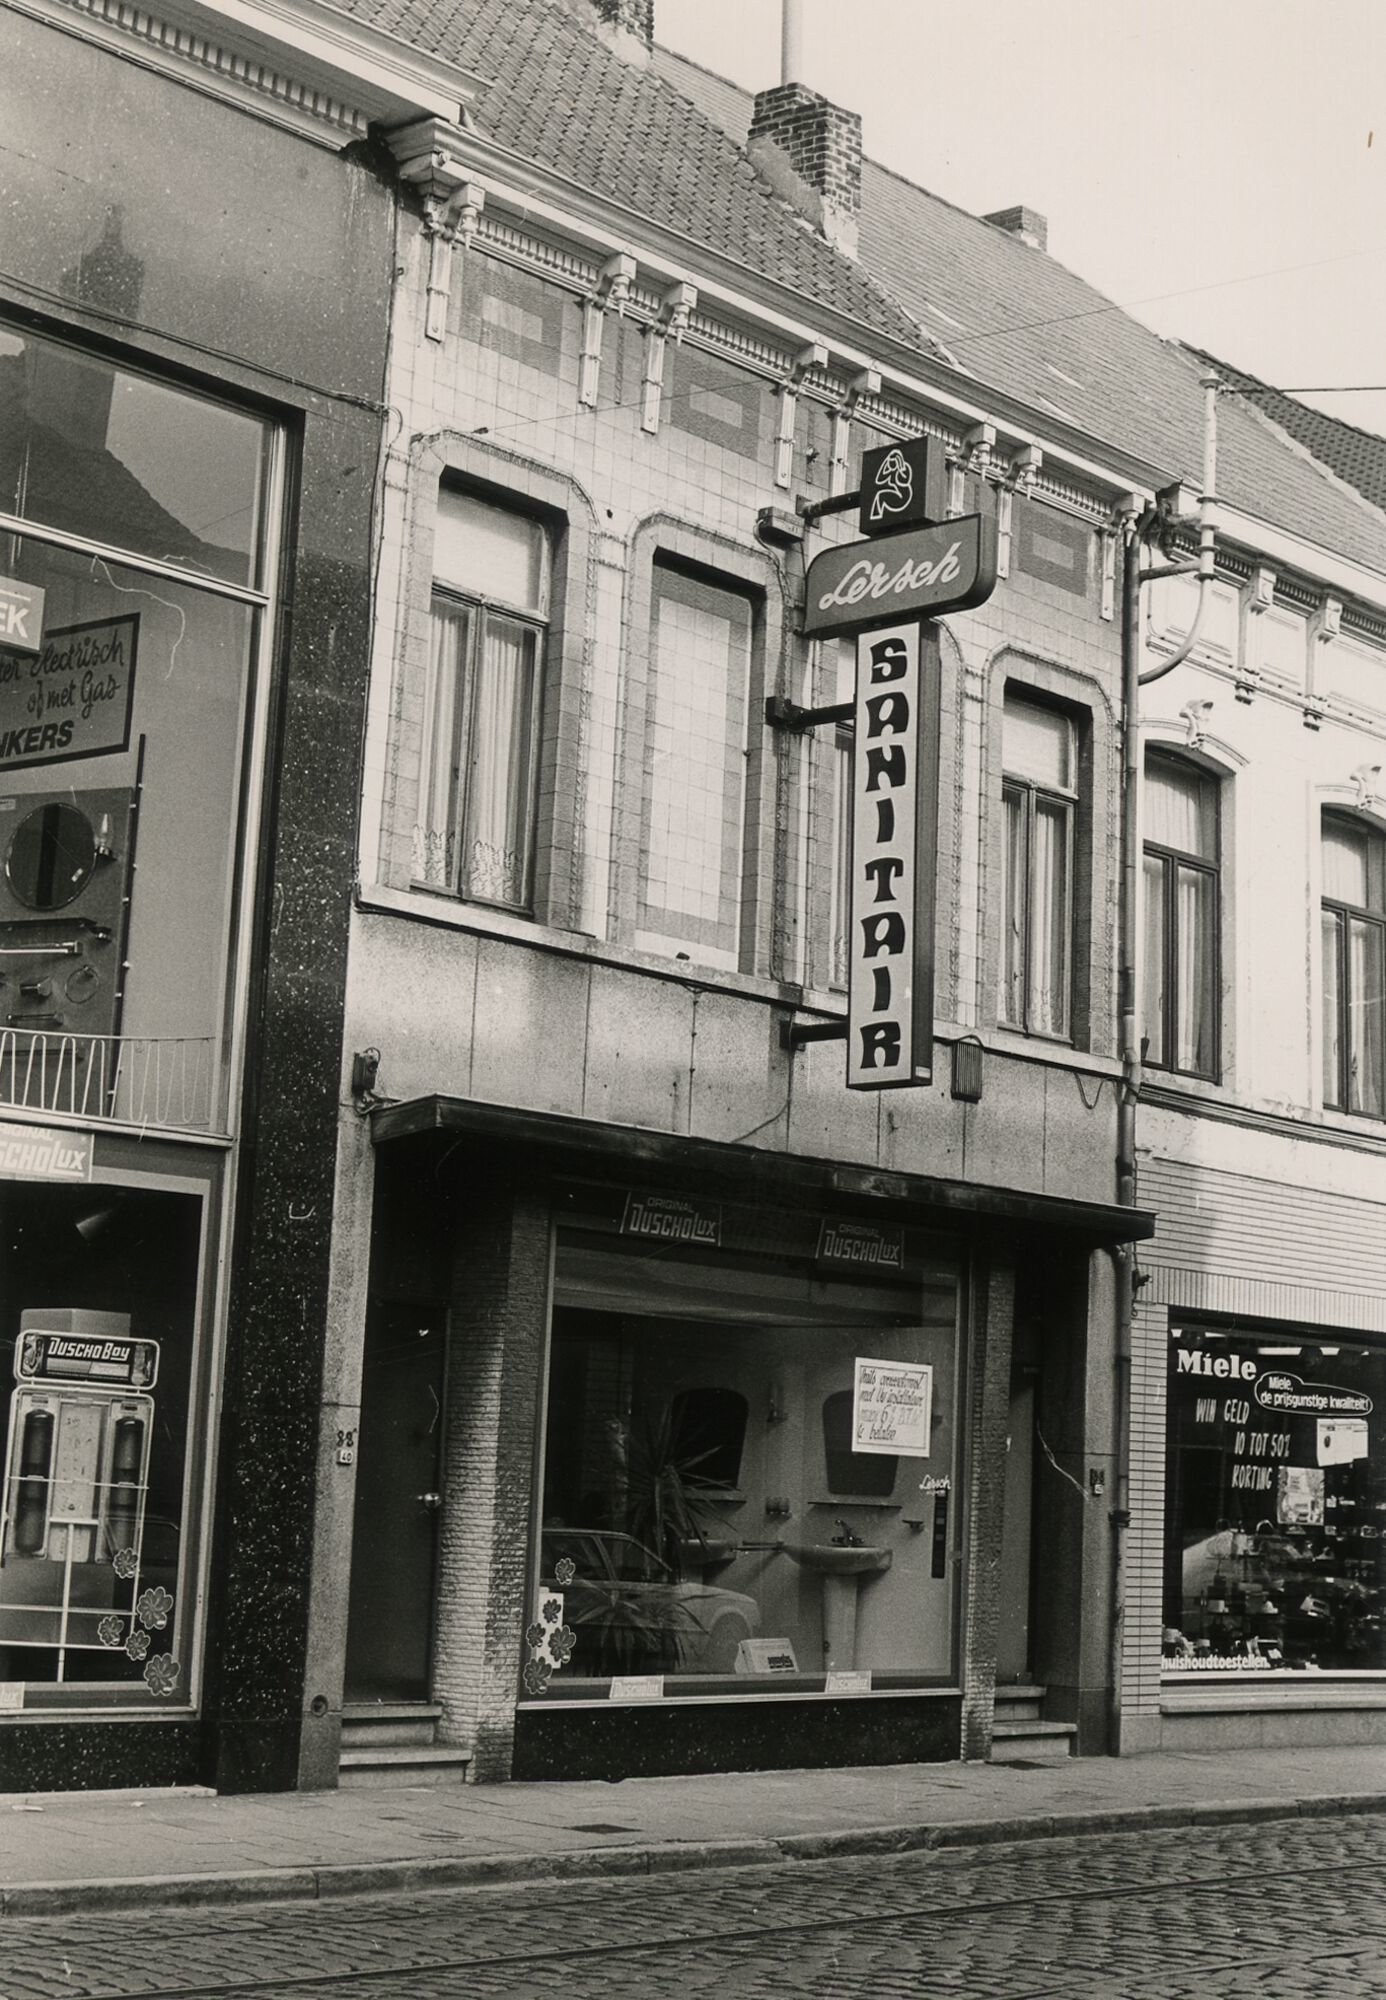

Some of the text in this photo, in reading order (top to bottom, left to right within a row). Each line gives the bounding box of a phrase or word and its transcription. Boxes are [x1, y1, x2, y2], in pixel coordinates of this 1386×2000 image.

[818, 541, 962, 610] Lersch
[46, 680, 76, 709] met
[80, 669, 121, 720] Gas
[860, 637, 910, 1069] SANITAIR
[1176, 1349, 1257, 1380] Miele
[1195, 1398, 1250, 1425] WIN GELD
[1260, 1391, 1273, 1404] de
[1249, 1432, 1270, 1456] TOT
[1231, 1464, 1273, 1491] KORTING
